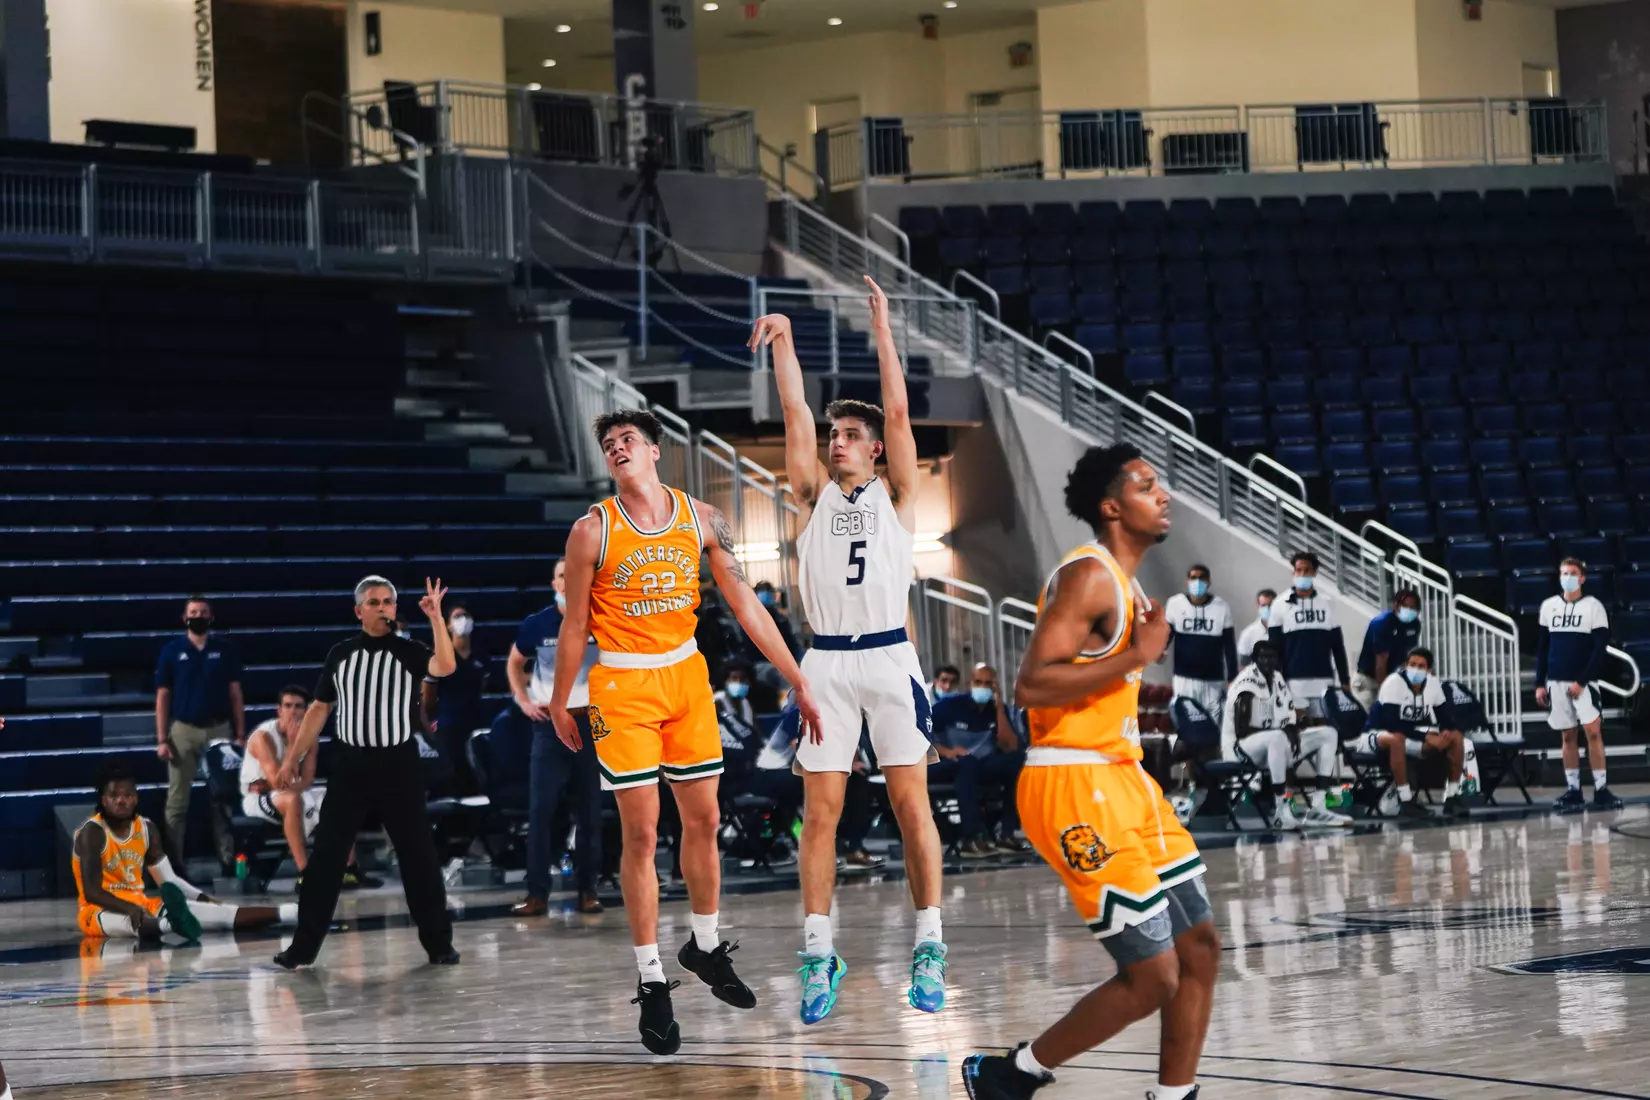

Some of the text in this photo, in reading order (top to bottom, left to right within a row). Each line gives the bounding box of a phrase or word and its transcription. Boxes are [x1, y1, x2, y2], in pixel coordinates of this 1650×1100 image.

[194, 0, 213, 92] WOMEN
[831, 511, 876, 536] CBU
[846, 540, 867, 586] 5
[1182, 617, 1215, 632] CBU
[1295, 609, 1326, 624] CBU
[1552, 615, 1583, 628] CBU
